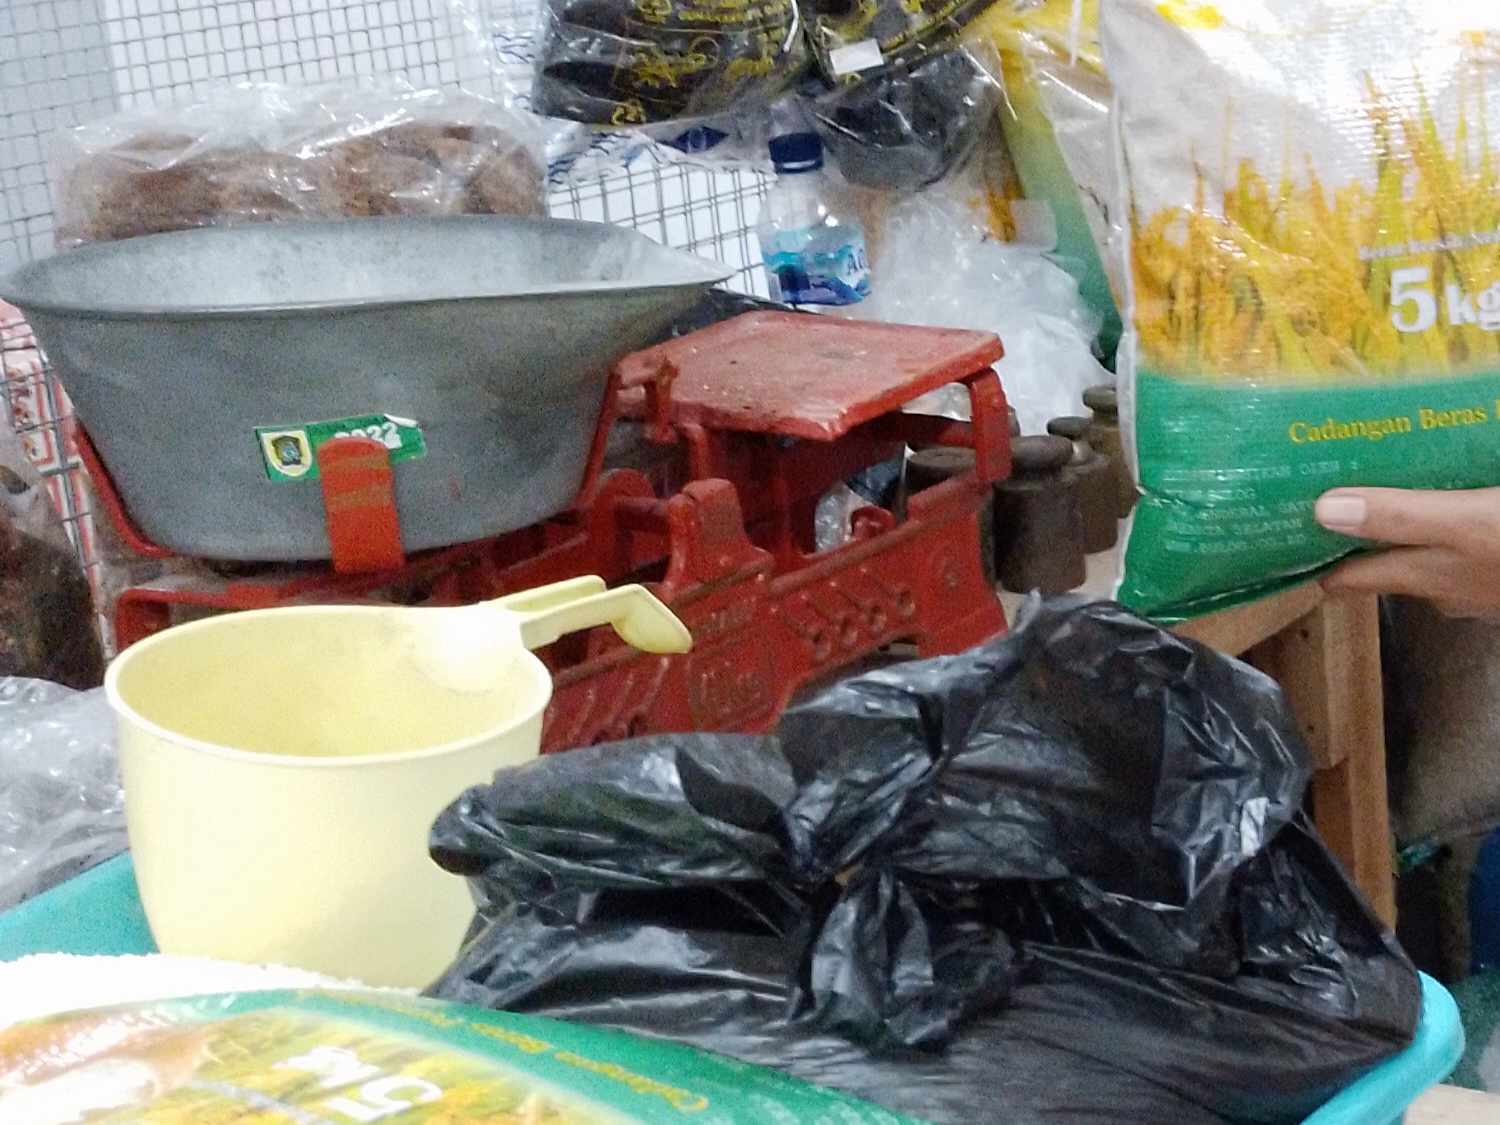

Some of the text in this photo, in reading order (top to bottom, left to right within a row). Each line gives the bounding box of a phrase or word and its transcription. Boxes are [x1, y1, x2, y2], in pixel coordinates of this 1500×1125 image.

[1390, 265, 1438, 334] 5
[1288, 416, 1413, 444] Cadangan
[1417, 404, 1489, 431] Beras
